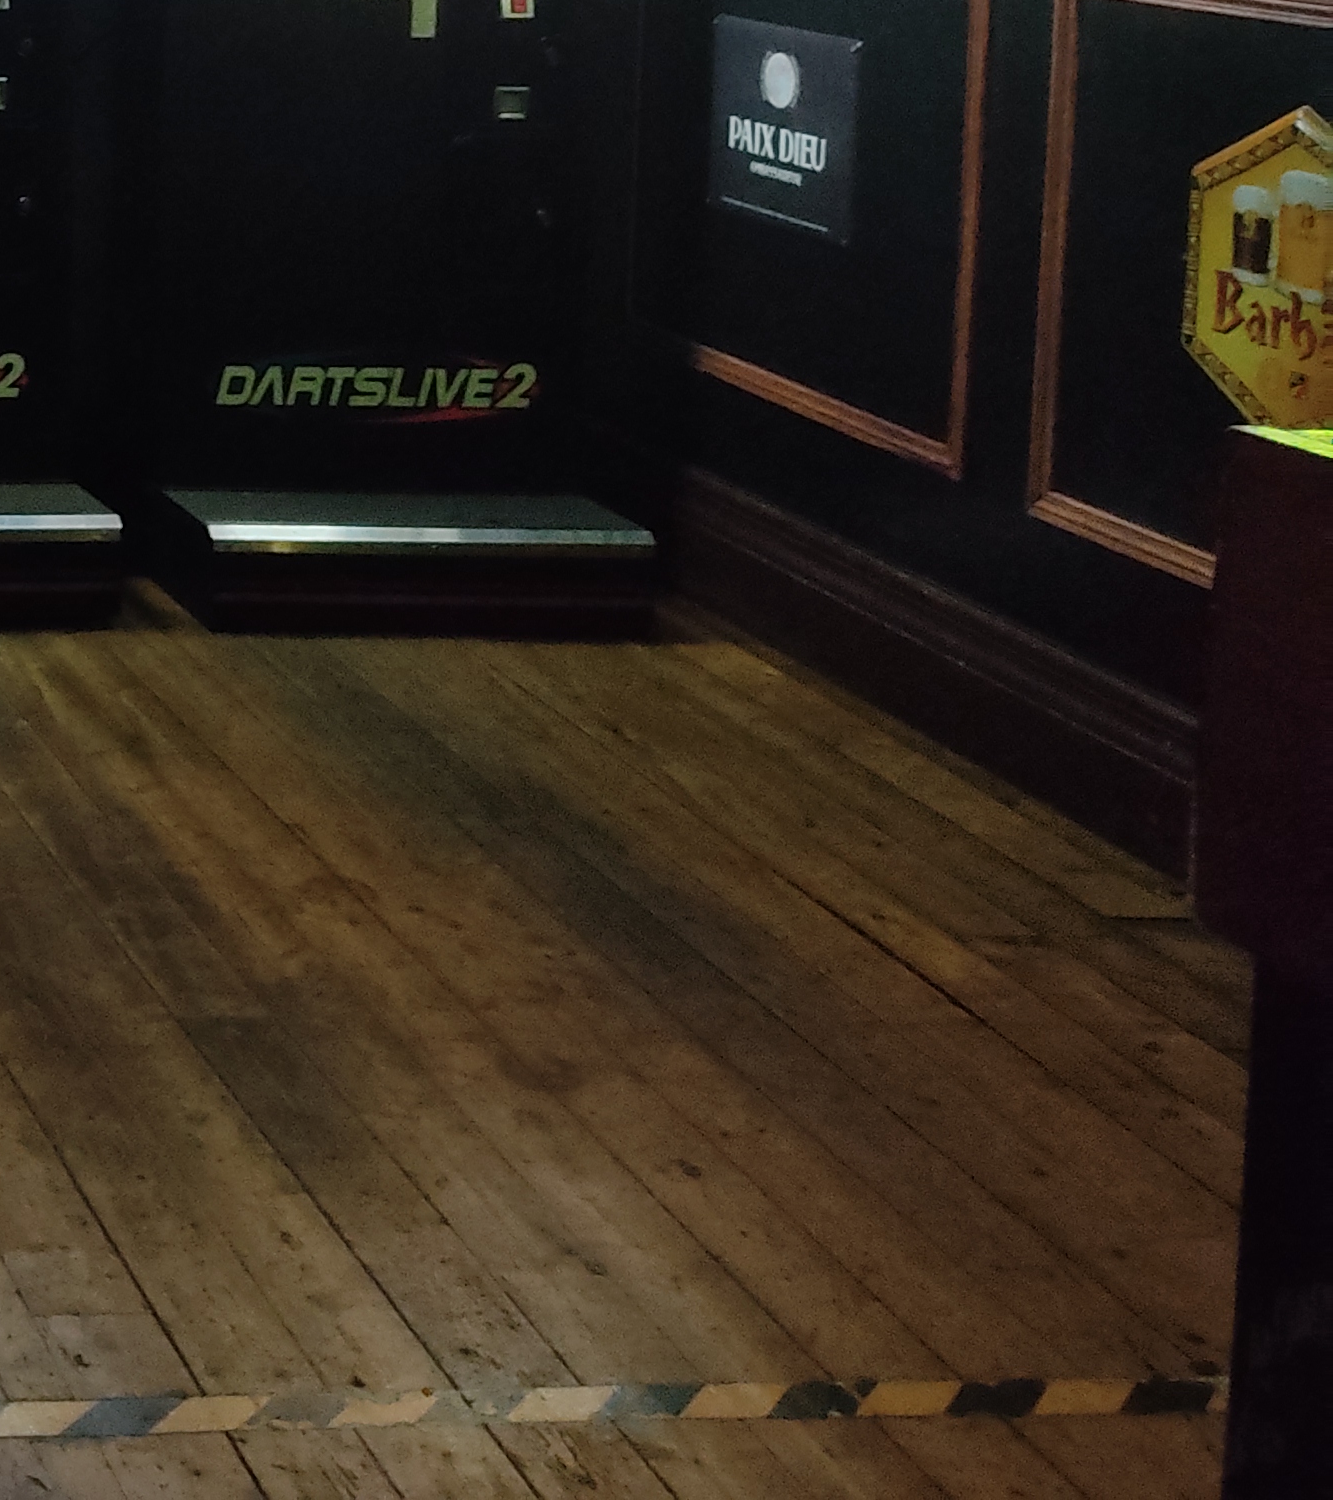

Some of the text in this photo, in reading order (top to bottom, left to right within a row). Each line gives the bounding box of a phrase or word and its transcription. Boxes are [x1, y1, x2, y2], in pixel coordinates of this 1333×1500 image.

[728, 115, 828, 173] PAIX DIEU
[216, 361, 537, 409] DARTSLIVE2
